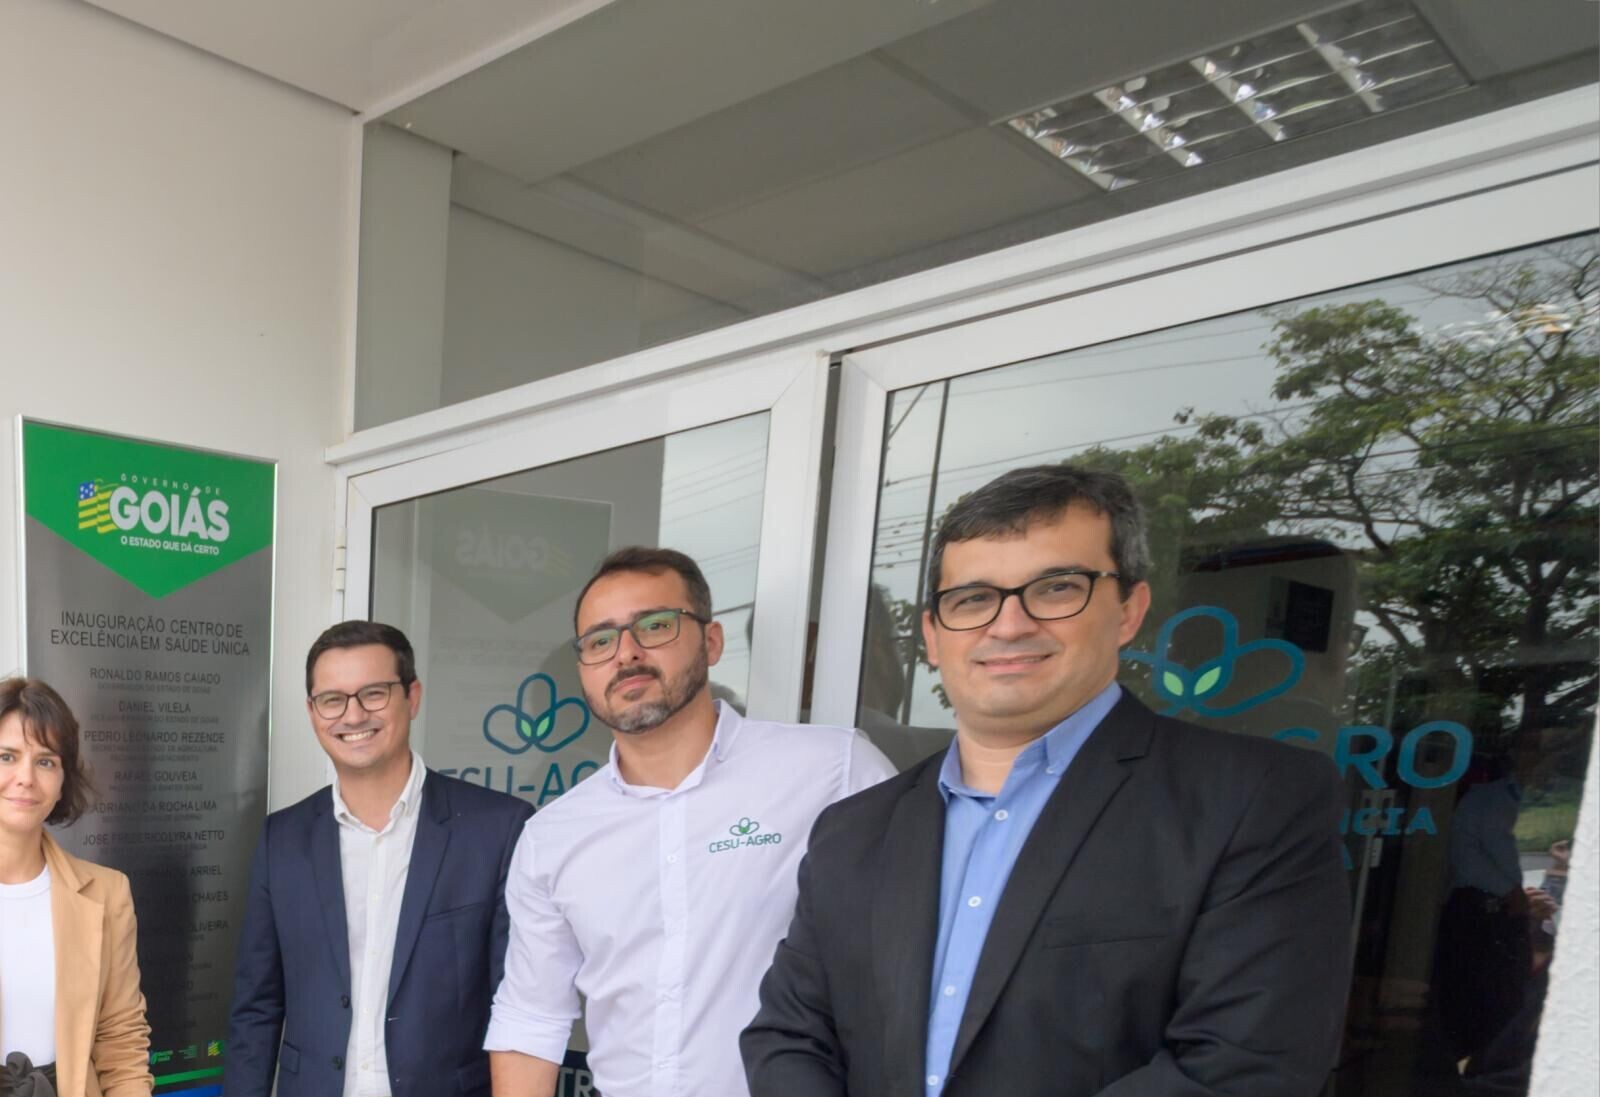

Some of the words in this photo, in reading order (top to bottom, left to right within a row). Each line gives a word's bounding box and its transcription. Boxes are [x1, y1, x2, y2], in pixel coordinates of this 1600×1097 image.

[121, 473, 189, 490] GOVERNO
[205, 486, 220, 495] DE
[109, 486, 230, 542] GOIÁS
[121, 536, 128, 545] O
[130, 537, 161, 549] ESTADO
[163, 541, 179, 551] QUE
[181, 541, 192, 552] DÁ
[193, 545, 220, 555] CERTO
[61, 611, 165, 634] INAUGURAÇÃO
[170, 619, 225, 637] CENTRO
[226, 624, 243, 638] DE
[51, 629, 139, 648] EXCELÊNCIA
[140, 635, 160, 651] EM
[165, 635, 208, 653] SAÚDE
[212, 639, 250, 656] ÚNICA
[90, 667, 142, 681] RONALDO
[145, 669, 181, 682] RAMOS
[183, 672, 221, 685] CAIADO
[118, 700, 154, 713] DANIEL
[158, 702, 191, 713] VILELA
[84, 730, 121, 742] PEDRO
[123, 730, 177, 743] LEONARDO
[181, 732, 225, 744] REZENDE
[154, 770, 198, 782] GOUVEIA
[158, 800, 193, 811] ROCHA
[195, 800, 217, 811] LIMA
[168, 831, 192, 842] LYRA
[194, 830, 225, 841] NETTO
[709, 833, 782, 853] CESU-AGRO
[190, 865, 225, 876] ARRIEL
[192, 891, 229, 903] CHAVES
